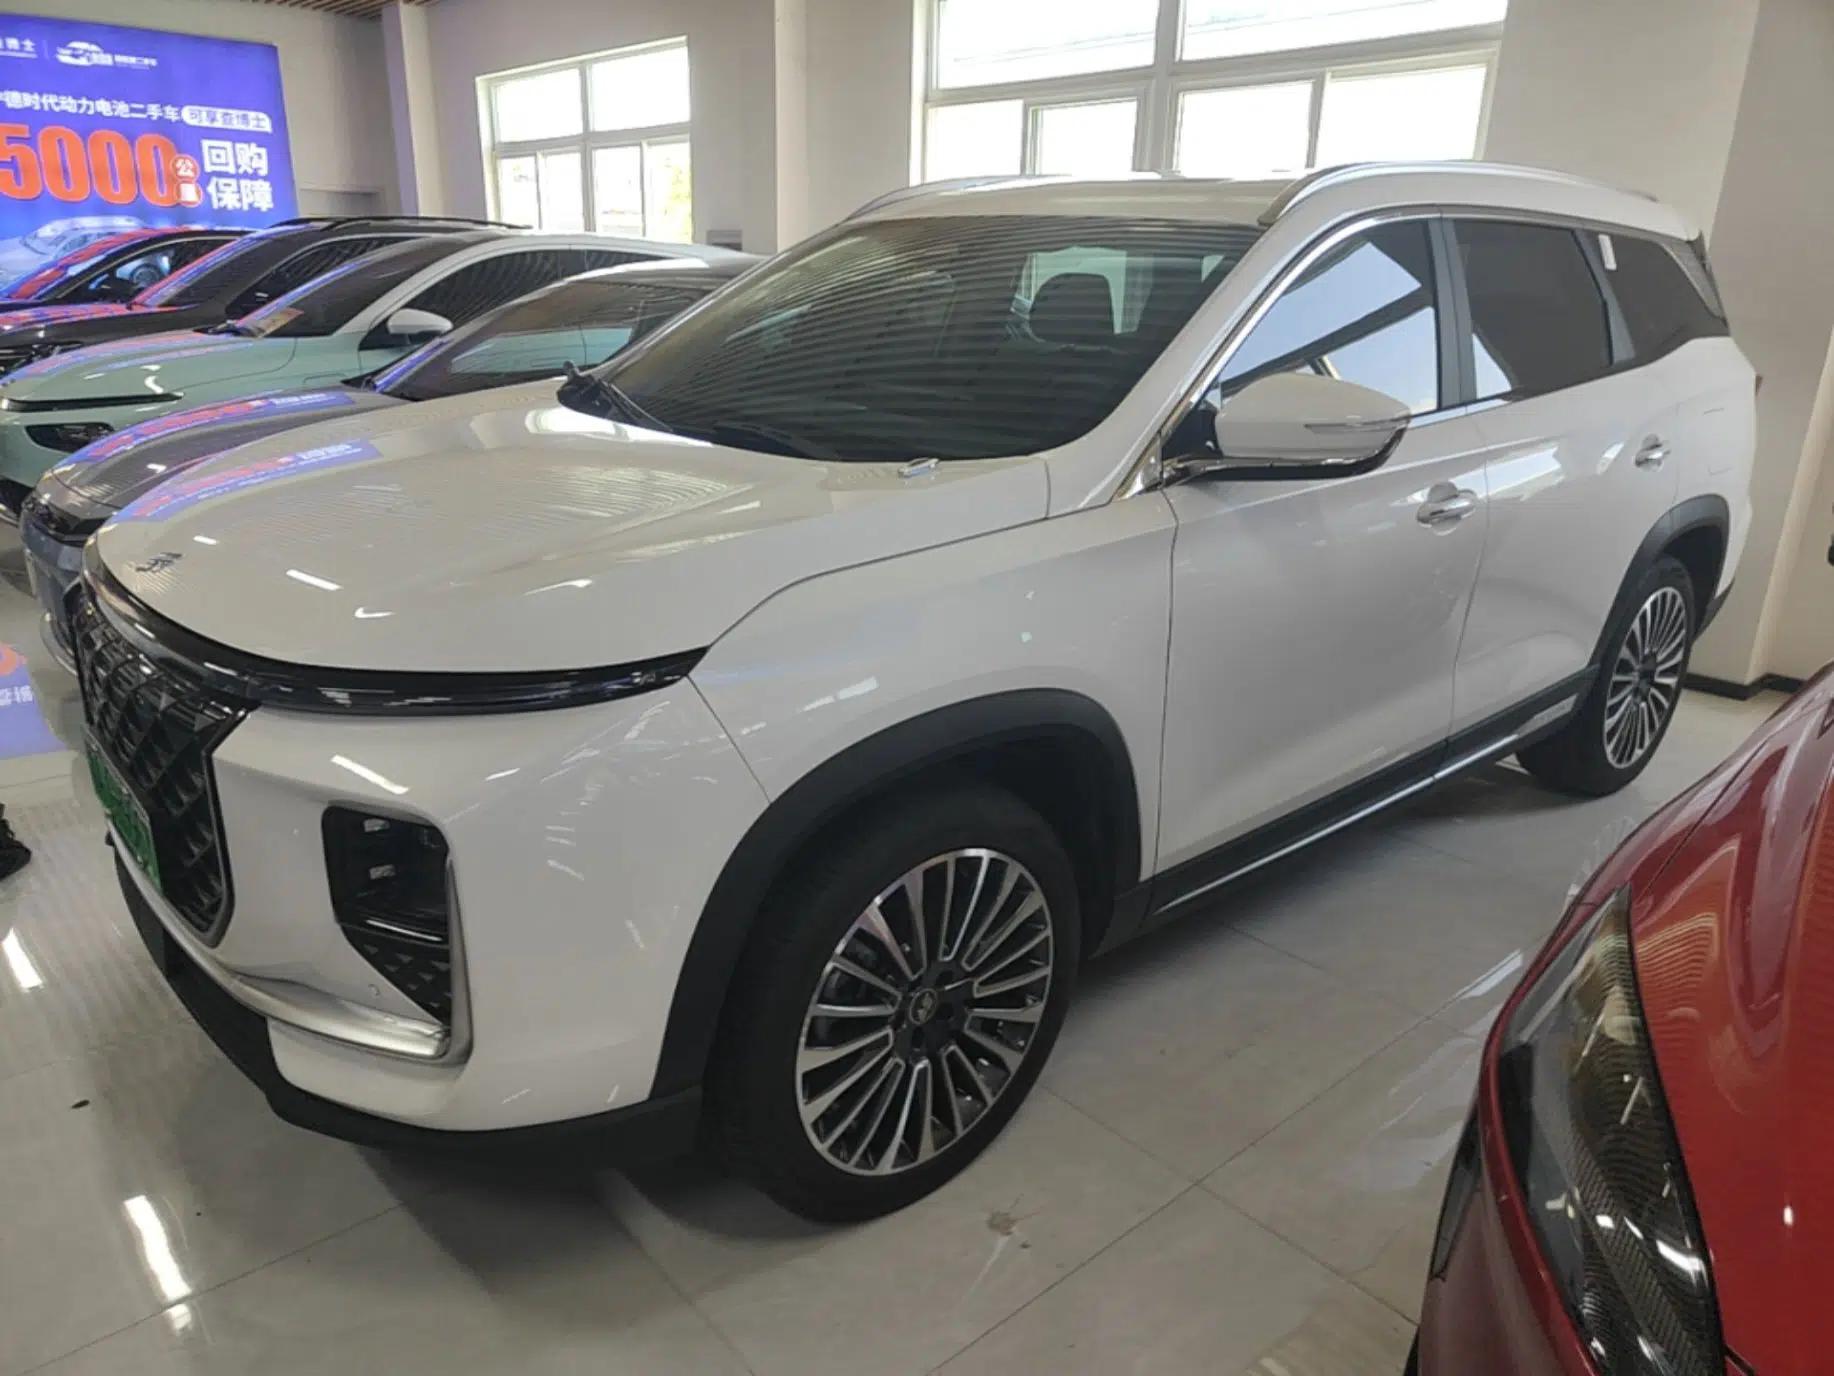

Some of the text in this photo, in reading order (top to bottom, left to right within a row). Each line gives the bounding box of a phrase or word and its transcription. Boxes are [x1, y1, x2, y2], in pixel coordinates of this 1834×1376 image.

[0, 123, 179, 207] 5000
[200, 139, 268, 176] 回购
[207, 176, 274, 212] 保障
